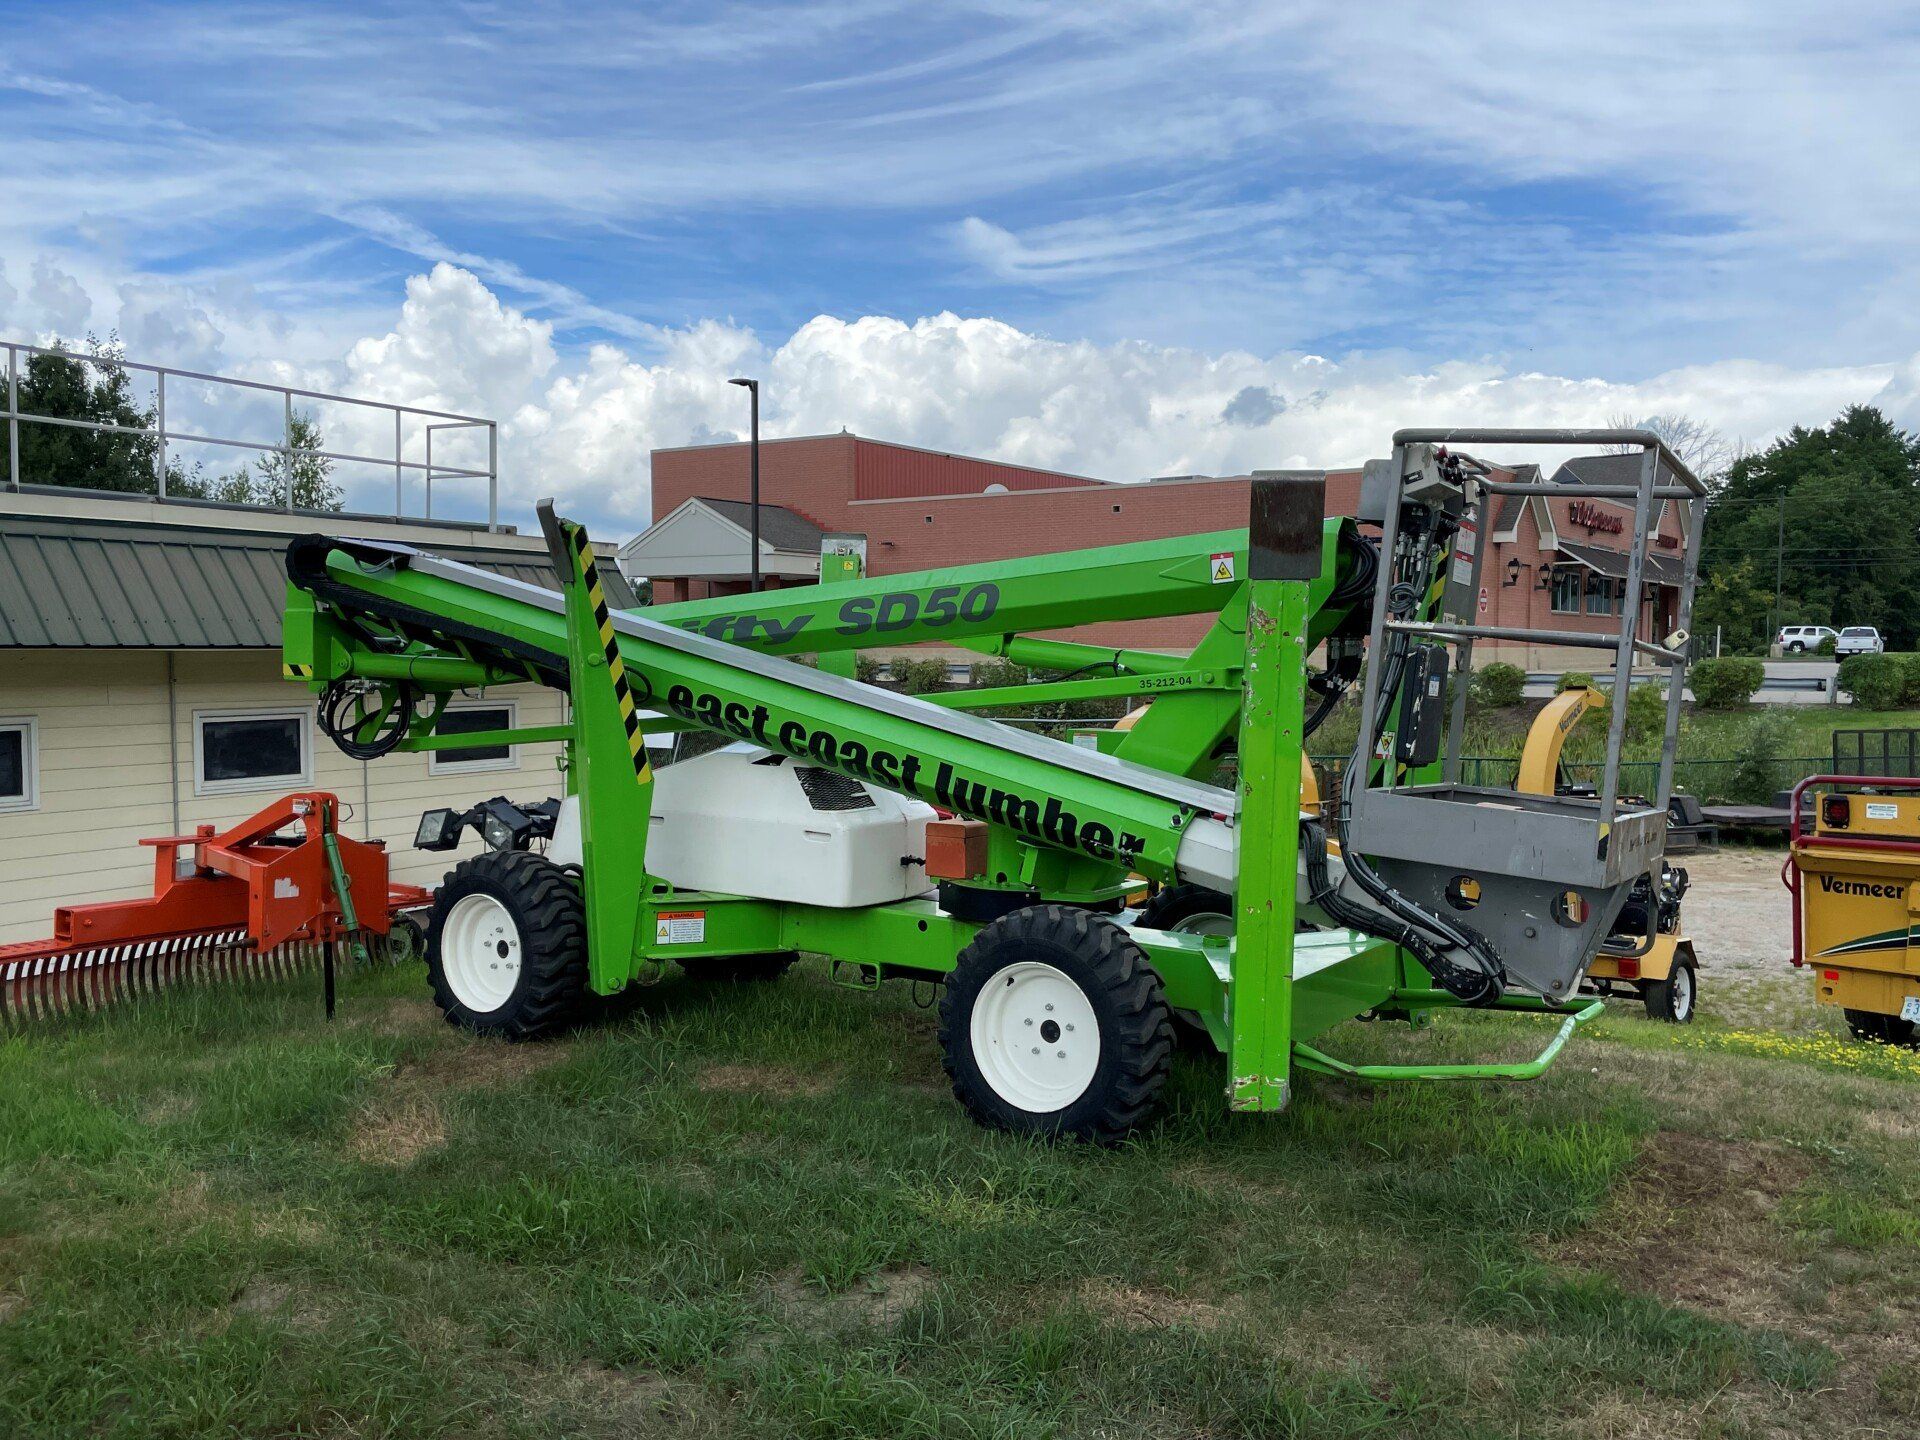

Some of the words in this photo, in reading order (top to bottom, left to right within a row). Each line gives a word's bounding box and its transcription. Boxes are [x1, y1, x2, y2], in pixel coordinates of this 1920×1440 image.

[834, 583, 1000, 636] SD50
[1139, 676, 1192, 689] 35-212-04
[667, 684, 772, 747] east
[778, 720, 922, 796] coast
[934, 761, 1147, 869] lumber
[1820, 874, 1904, 900] Vermeer
